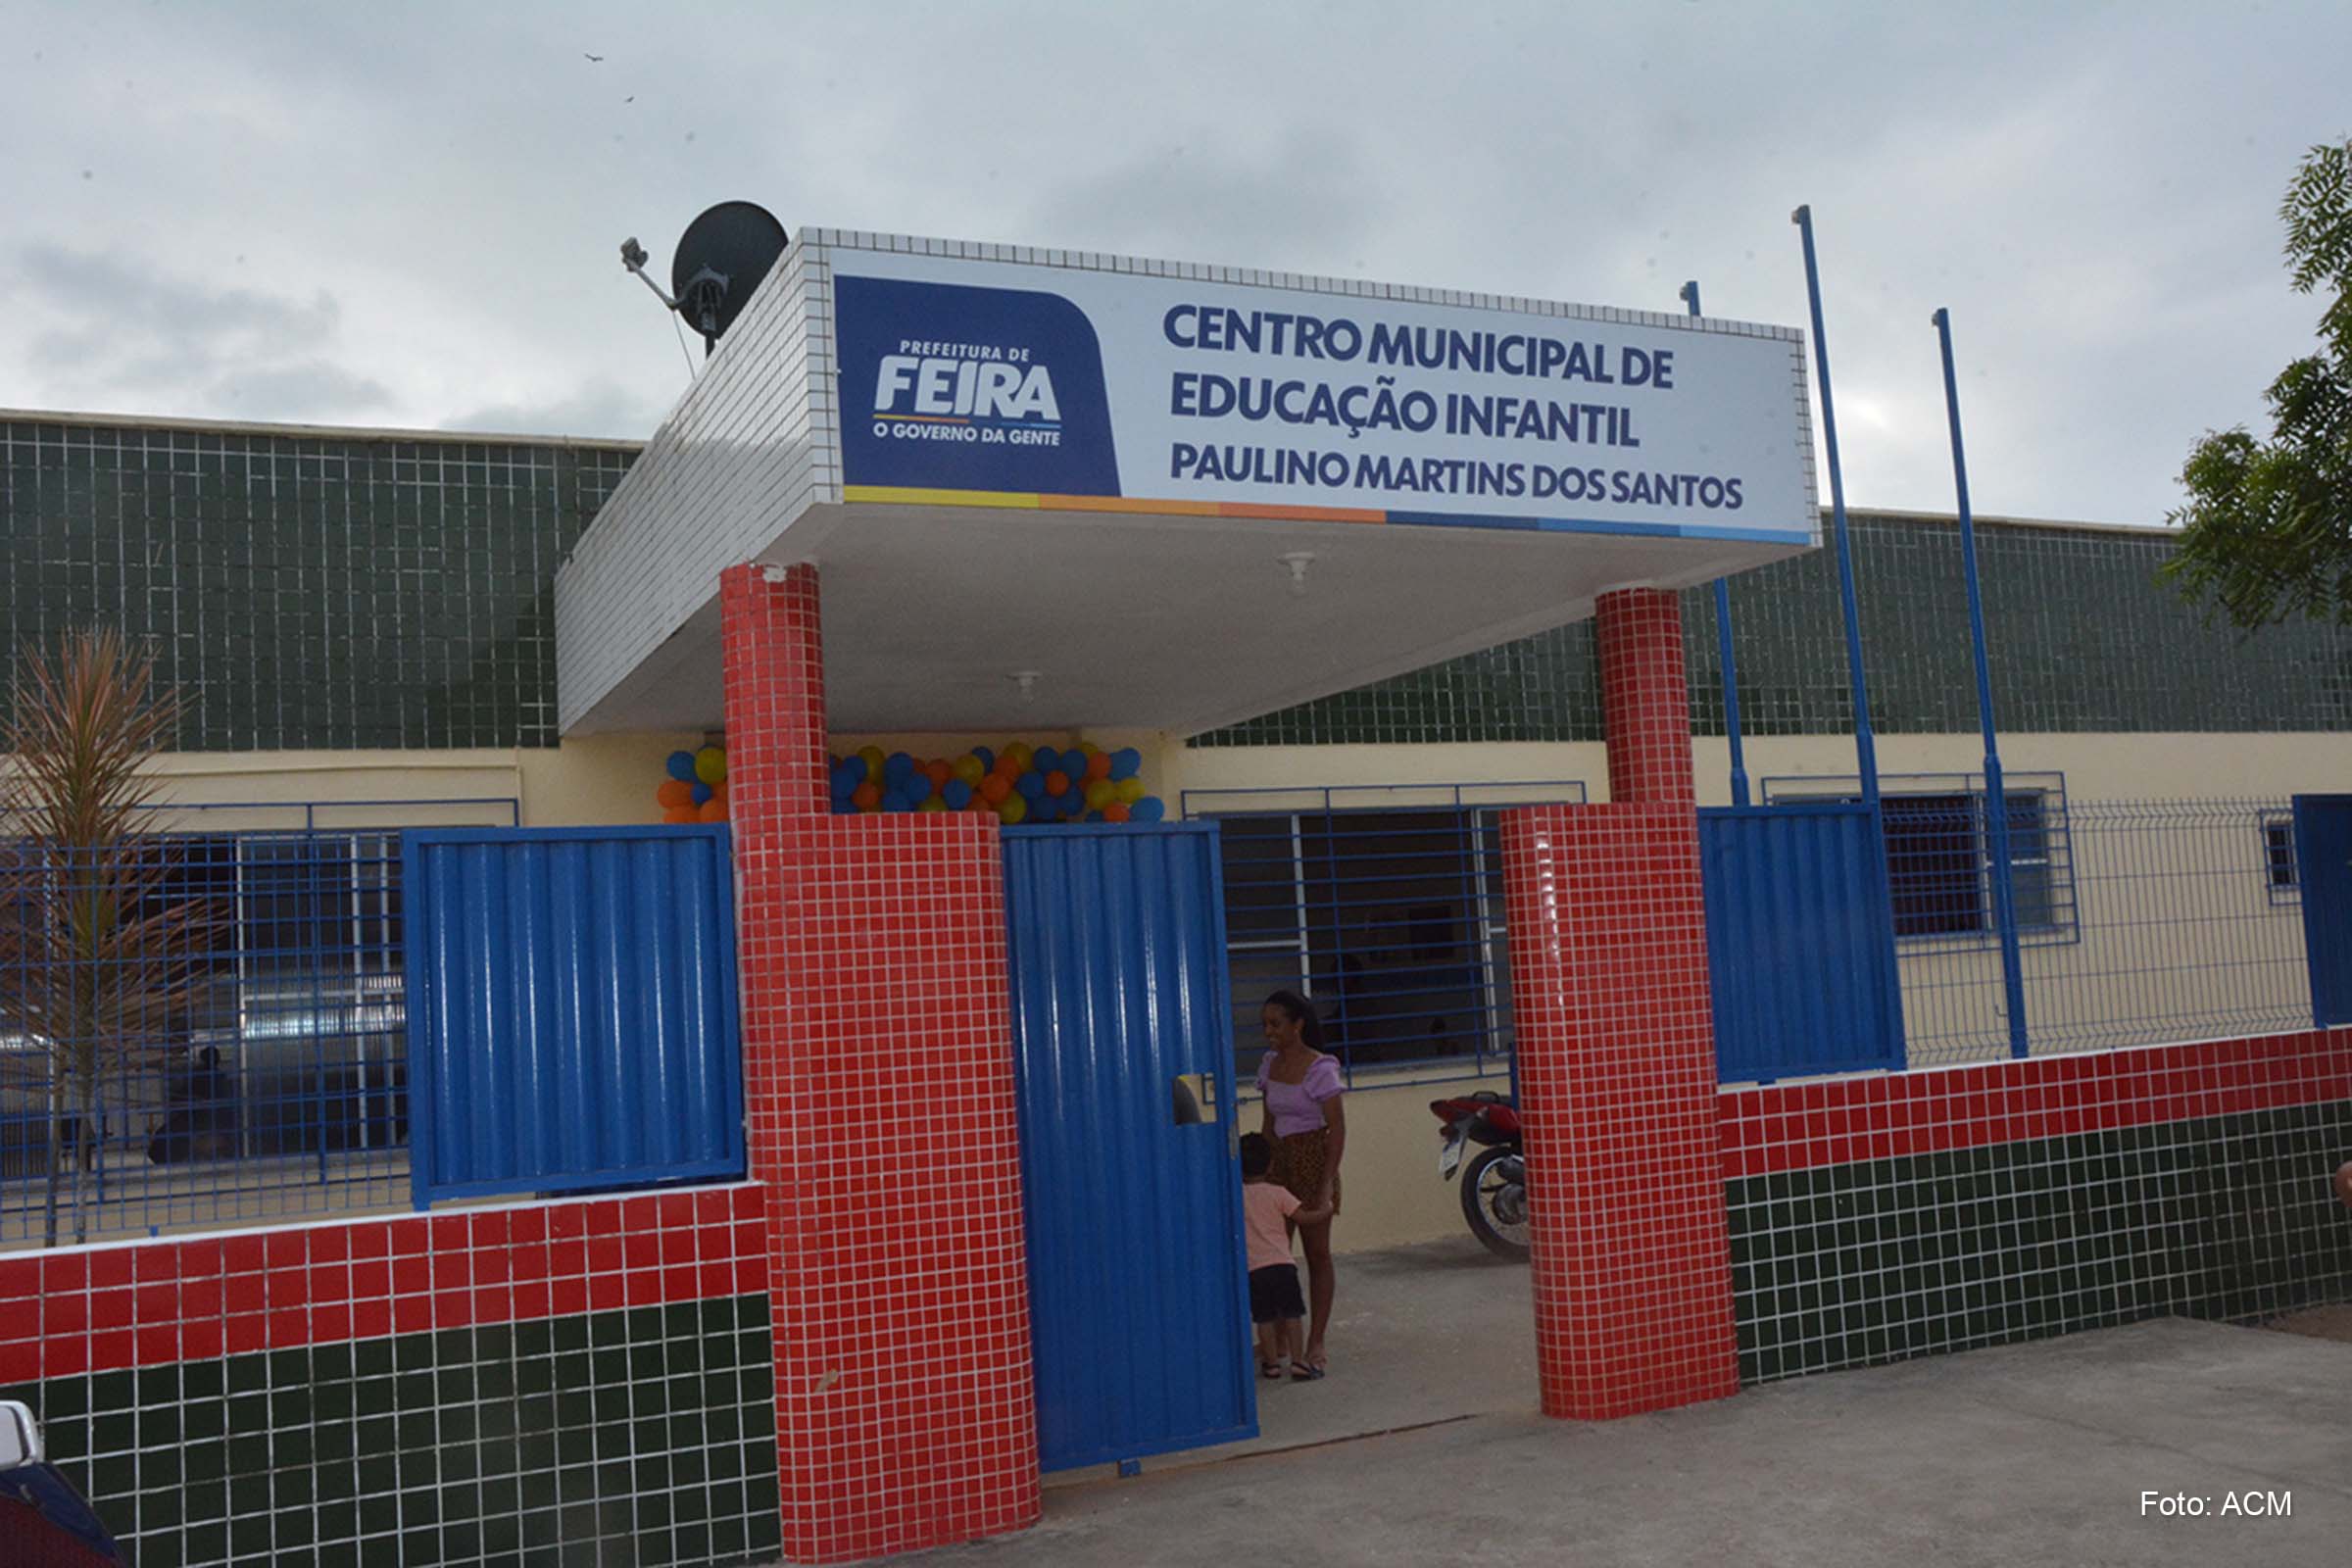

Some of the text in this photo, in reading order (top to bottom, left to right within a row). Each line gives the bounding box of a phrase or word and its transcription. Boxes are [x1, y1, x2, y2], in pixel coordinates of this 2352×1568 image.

[900, 340, 1029, 362] PREFEITURA DE
[1163, 304, 1674, 389] CENTRO MUNICIPAL DE
[874, 355, 1061, 420] FEIRA
[1171, 371, 1641, 447] EDUCAÇÃO INFANTIL
[873, 422, 1060, 446] O GOVERNO DA GENTE
[1171, 443, 1743, 510] PAULINO MARTINS DOS SANTOS
